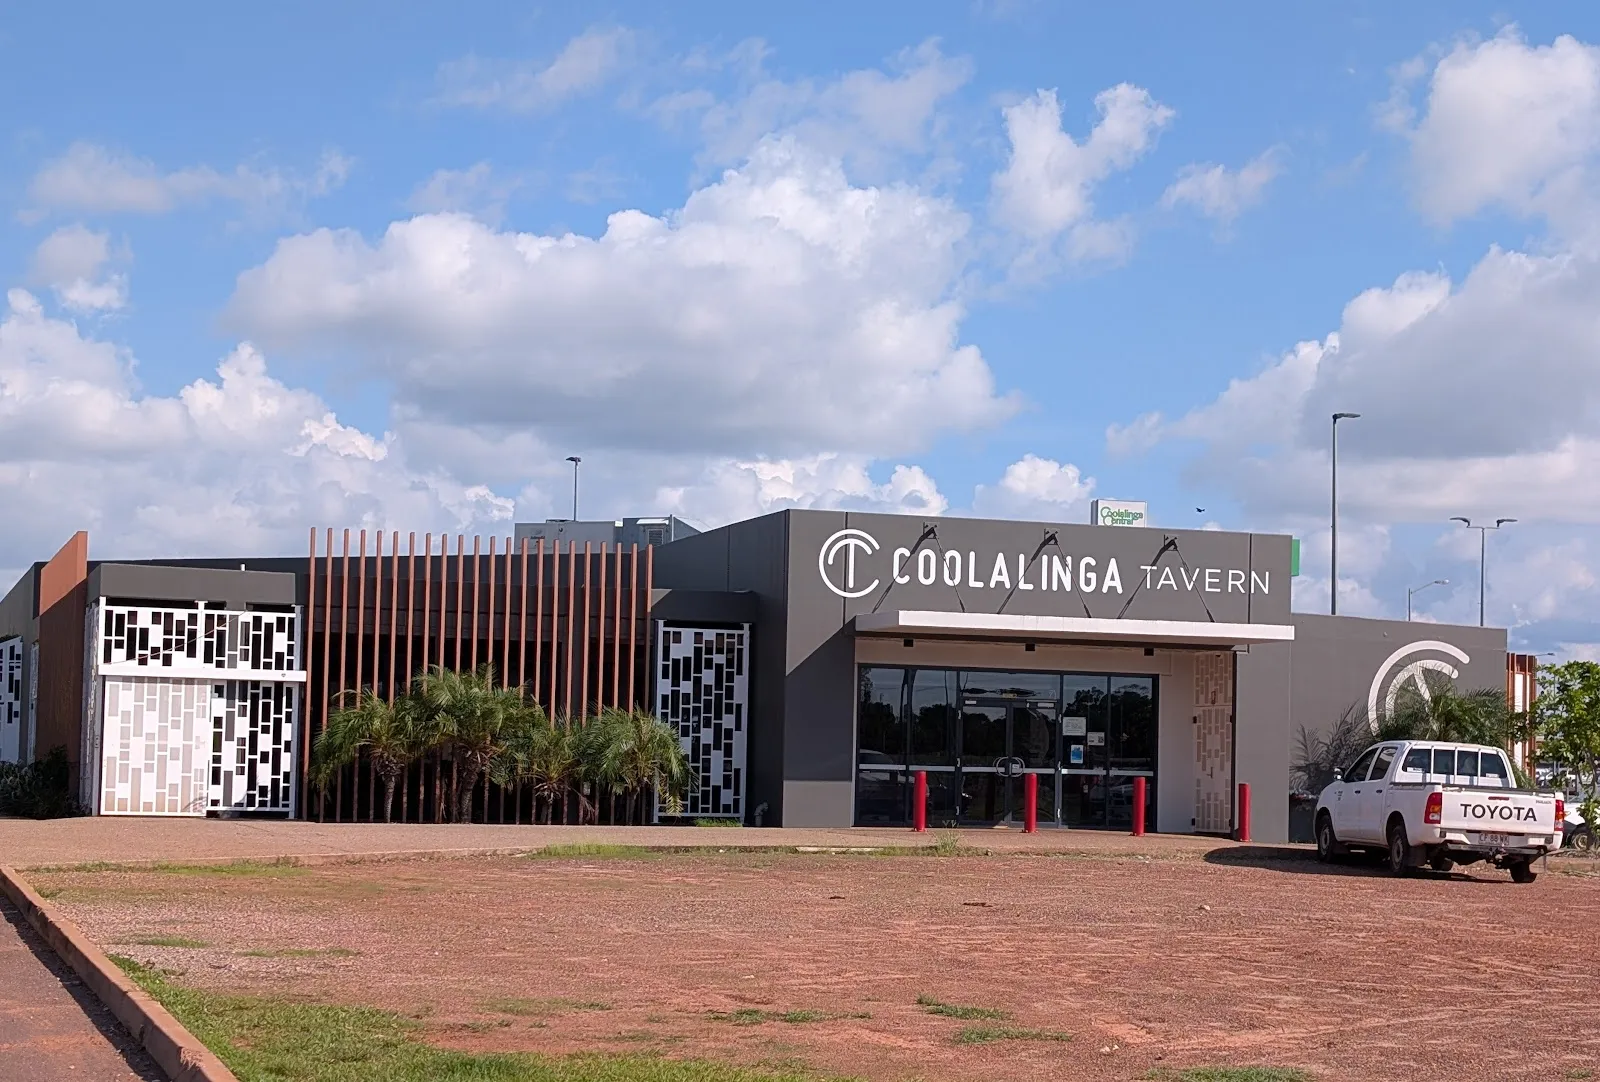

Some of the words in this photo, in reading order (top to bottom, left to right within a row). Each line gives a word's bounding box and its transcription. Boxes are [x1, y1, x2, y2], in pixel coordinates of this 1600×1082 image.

[1100, 506, 1143, 520] Coolalinga
[1103, 516, 1134, 526] Central
[893, 547, 1123, 594] COOLALINGA
[1140, 565, 1270, 595] TAVERN
[1460, 803, 1538, 822] TOYOTA
